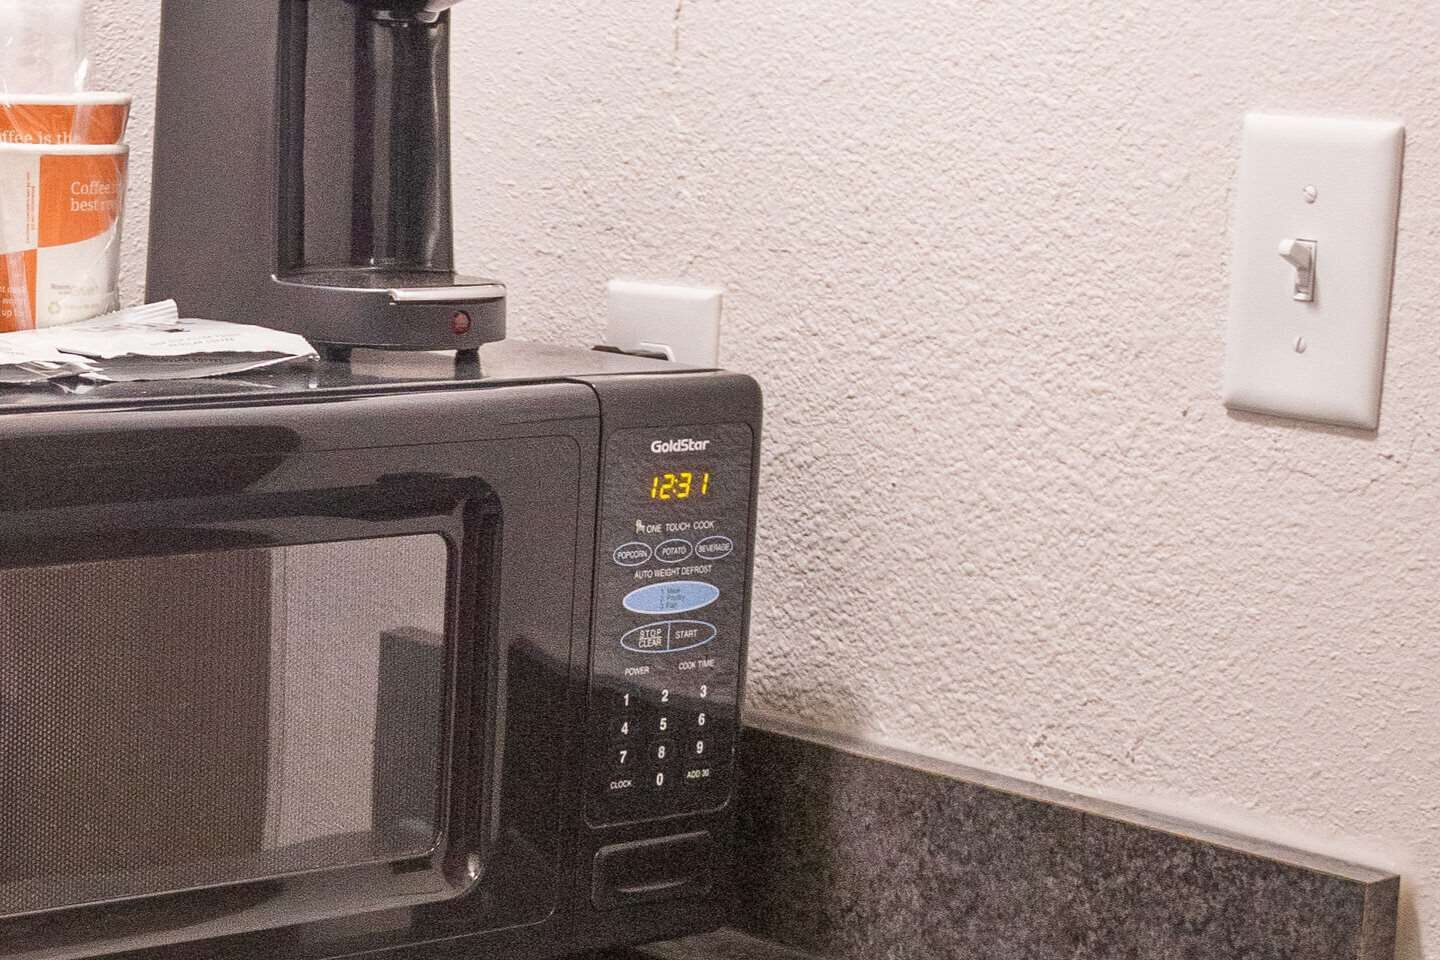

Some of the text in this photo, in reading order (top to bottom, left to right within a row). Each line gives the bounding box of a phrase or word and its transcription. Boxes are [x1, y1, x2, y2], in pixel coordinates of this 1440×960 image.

[70, 180, 110, 195] Coffee
[70, 197, 98, 212] best
[651, 438, 710, 453] GoldStar
[650, 472, 709, 500] 12:31
[646, 520, 715, 534] ONE TOUCH COOK
[617, 550, 648, 560] POPCORN
[662, 546, 687, 556] POTATO
[634, 564, 712, 579] AUTO WEIGHT DEFROST
[640, 628, 662, 638] STOP
[675, 629, 698, 639] START
[638, 638, 662, 648] CLEAR
[624, 666, 650, 676] POWER
[678, 658, 715, 671] COOK TIME
[661, 689, 669, 702] 2
[699, 684, 707, 698] 3
[623, 693, 630, 707] 1
[659, 717, 667, 731] 5
[698, 712, 706, 726] 6
[621, 721, 629, 735] 4
[657, 745, 665, 759] 8
[696, 740, 704, 754] 9
[620, 750, 628, 764] 7
[656, 772, 664, 786] 0
[686, 769, 701, 779] ADD
[610, 779, 633, 790] CLOCK
